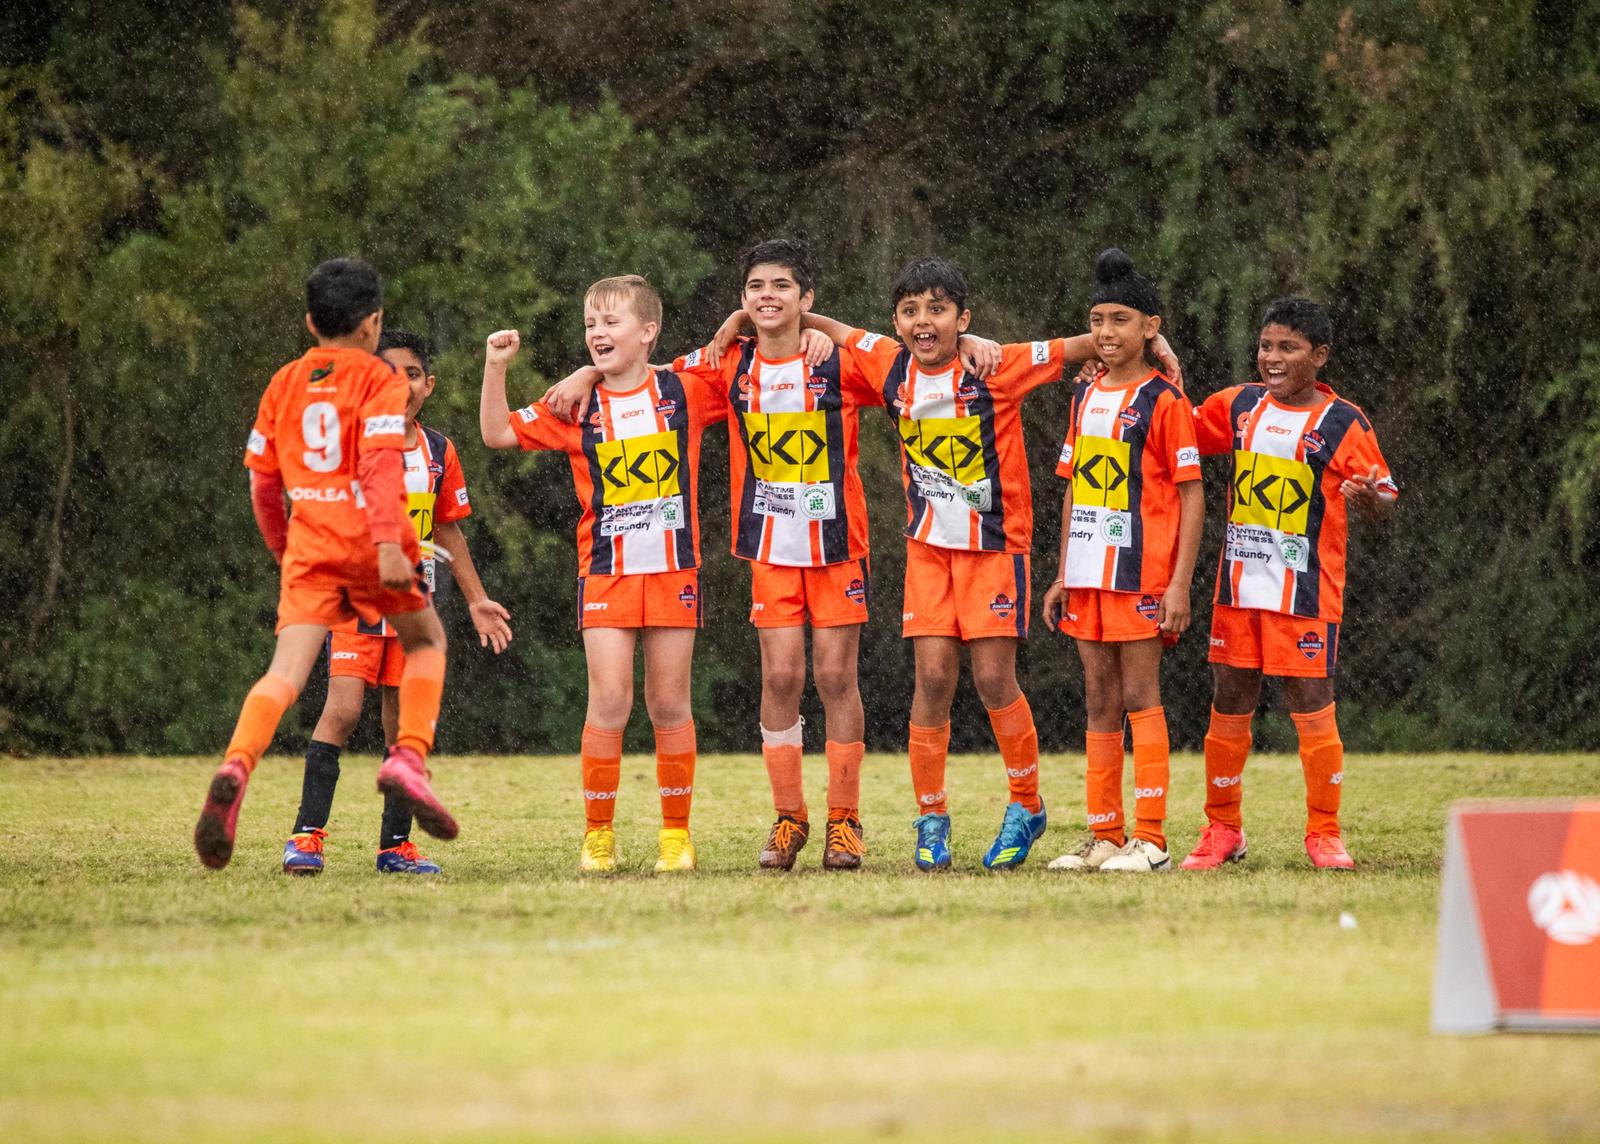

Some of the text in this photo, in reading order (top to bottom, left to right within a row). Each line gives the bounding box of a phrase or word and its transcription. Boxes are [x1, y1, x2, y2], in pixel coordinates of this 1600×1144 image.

[302, 401, 342, 472] 9
[288, 487, 348, 501] ODLEA
[615, 504, 653, 513] ANYTIME
[767, 504, 796, 518] Laundry
[614, 522, 651, 531] Laundry
[1068, 531, 1093, 541] ndry
[1235, 549, 1272, 563] Laundry
